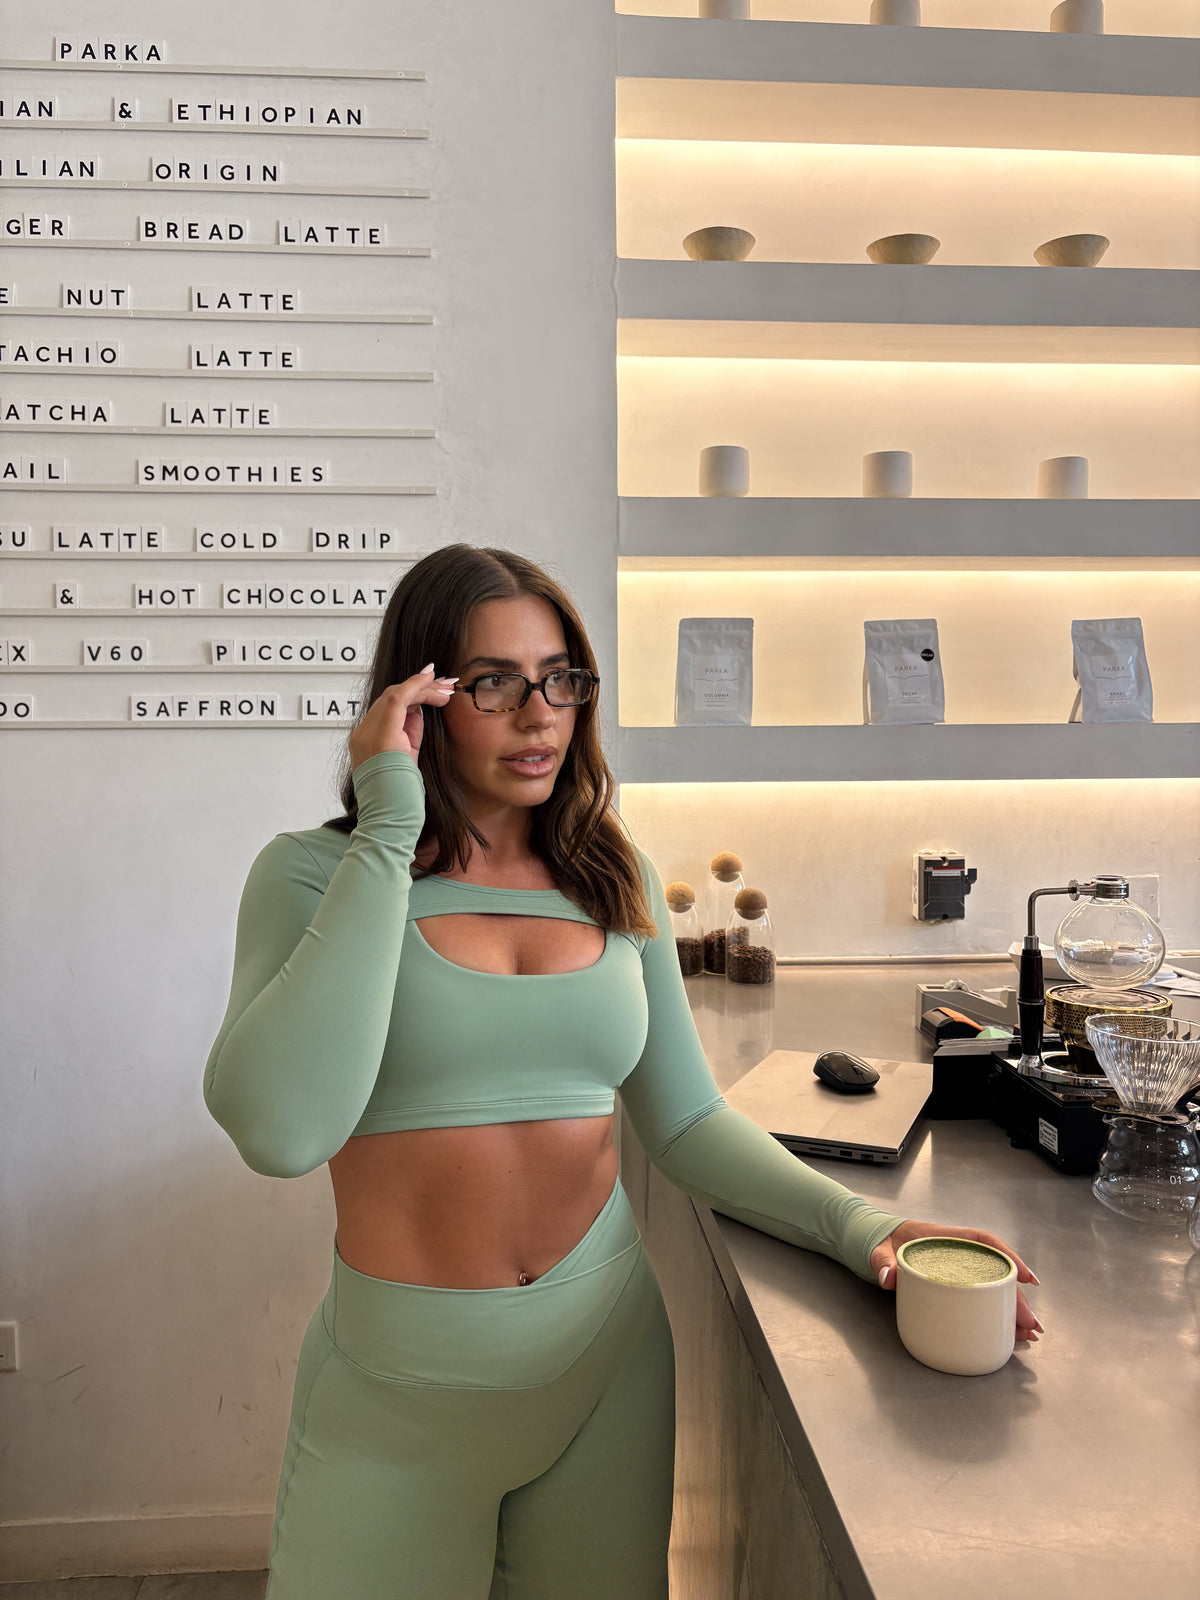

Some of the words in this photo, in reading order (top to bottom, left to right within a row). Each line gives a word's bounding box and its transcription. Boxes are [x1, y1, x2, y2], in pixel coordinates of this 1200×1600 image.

[60, 42, 161, 61] PARKA
[118, 102, 132, 119] &
[177, 104, 362, 126] ETHIOPIAN
[155, 162, 277, 182] ORIGIN
[6, 218, 63, 236] GER
[144, 221, 244, 241] BREAD
[284, 226, 380, 245] LATTE
[67, 288, 125, 306] NUT
[196, 292, 294, 311] LATTE
[196, 350, 293, 368] LATTE
[0, 403, 107, 423] ATCHA
[170, 407, 270, 425] LATTE
[2, 462, 60, 480] AIL
[143, 465, 323, 483] SMOOTHIES
[0, 531, 26, 548] U
[58, 531, 158, 549] LATTE
[200, 532, 277, 549] COLD
[315, 532, 391, 549] DRIP
[60, 588, 74, 605] &
[138, 588, 195, 605] HOT
[227, 587, 387, 605] CHOCOLAT
[0, 645, 26, 662] X
[87, 645, 143, 662] V60
[216, 644, 357, 662] PICCOLO
[136, 699, 275, 717] SAFFRON
[306, 700, 361, 718] LAT
[1169, 1175, 1183, 1185] 01
